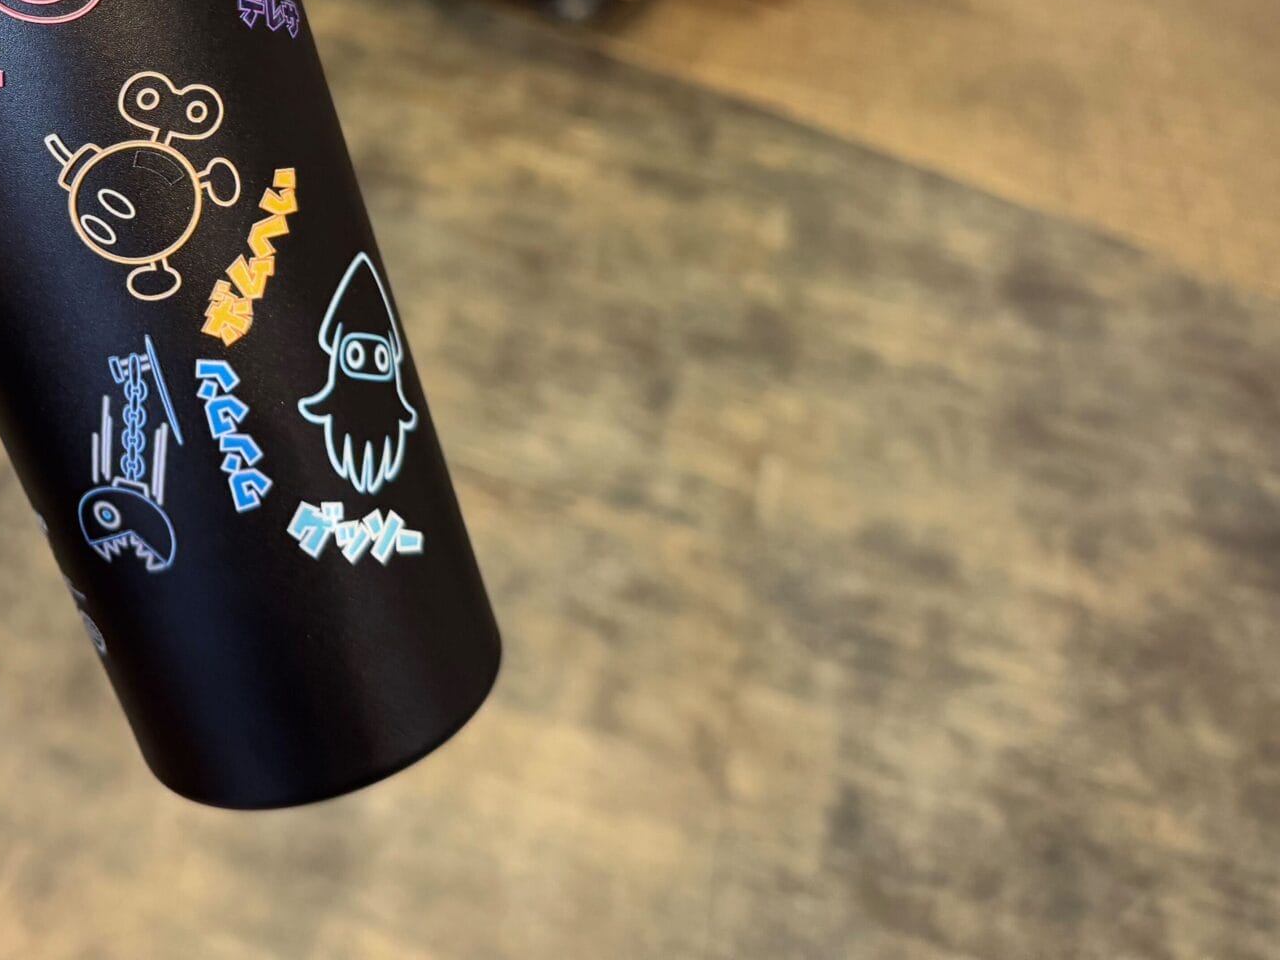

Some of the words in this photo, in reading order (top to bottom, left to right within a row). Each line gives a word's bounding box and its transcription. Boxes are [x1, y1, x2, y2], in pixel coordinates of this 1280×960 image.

[195, 358, 273, 513] ワンワン
[286, 500, 424, 567] ゲッソー
